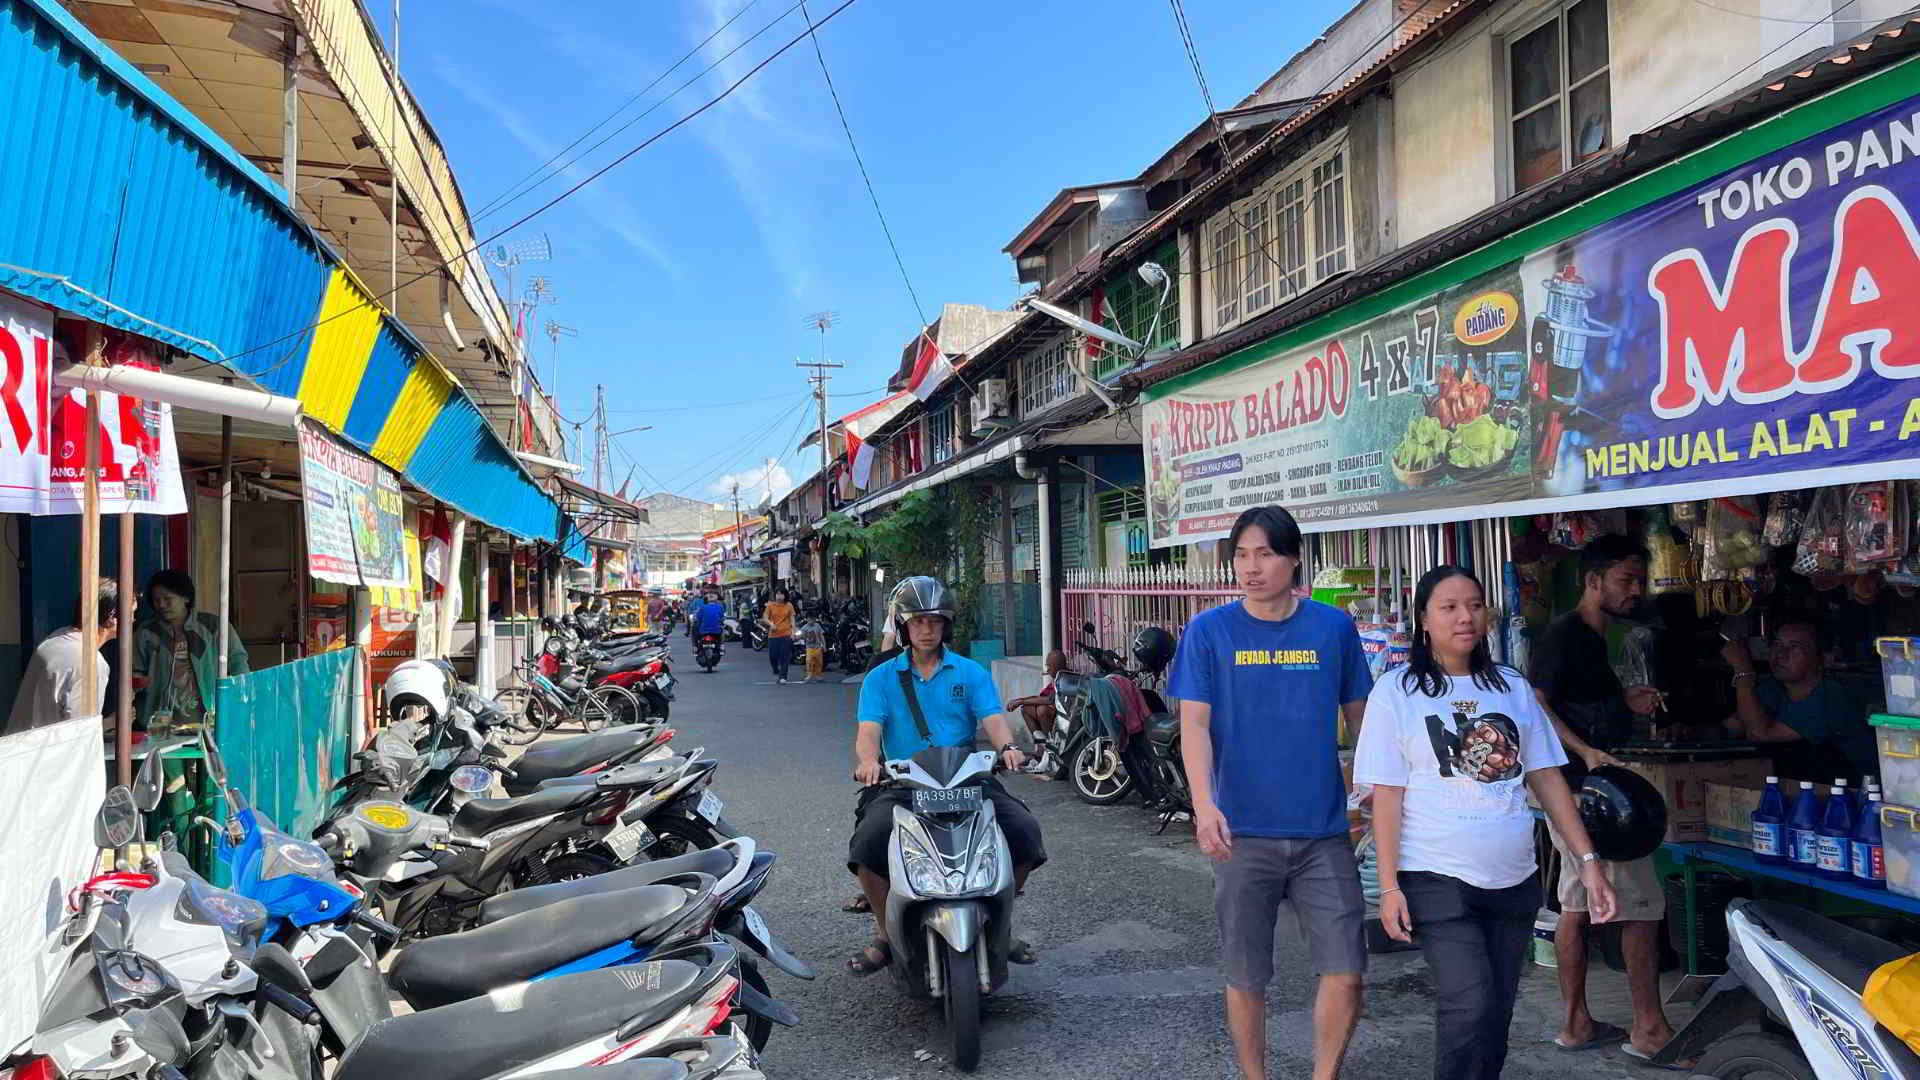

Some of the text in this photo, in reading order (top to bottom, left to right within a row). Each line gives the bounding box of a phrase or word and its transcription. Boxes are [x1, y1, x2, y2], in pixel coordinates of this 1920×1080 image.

[1697, 156, 1813, 230] TOKO
[1464, 307, 1505, 337] PADANG
[1168, 399, 1238, 456] KRIPIK
[1243, 340, 1351, 436] BALADO
[1358, 330, 1382, 401] 4
[1413, 304, 1441, 386] 7
[1337, 455, 1364, 472] RENDANG
[1585, 428, 1740, 480] MENJUAL
[1748, 407, 1858, 459] ALAT
[1235, 649, 1271, 665] NEVADA
